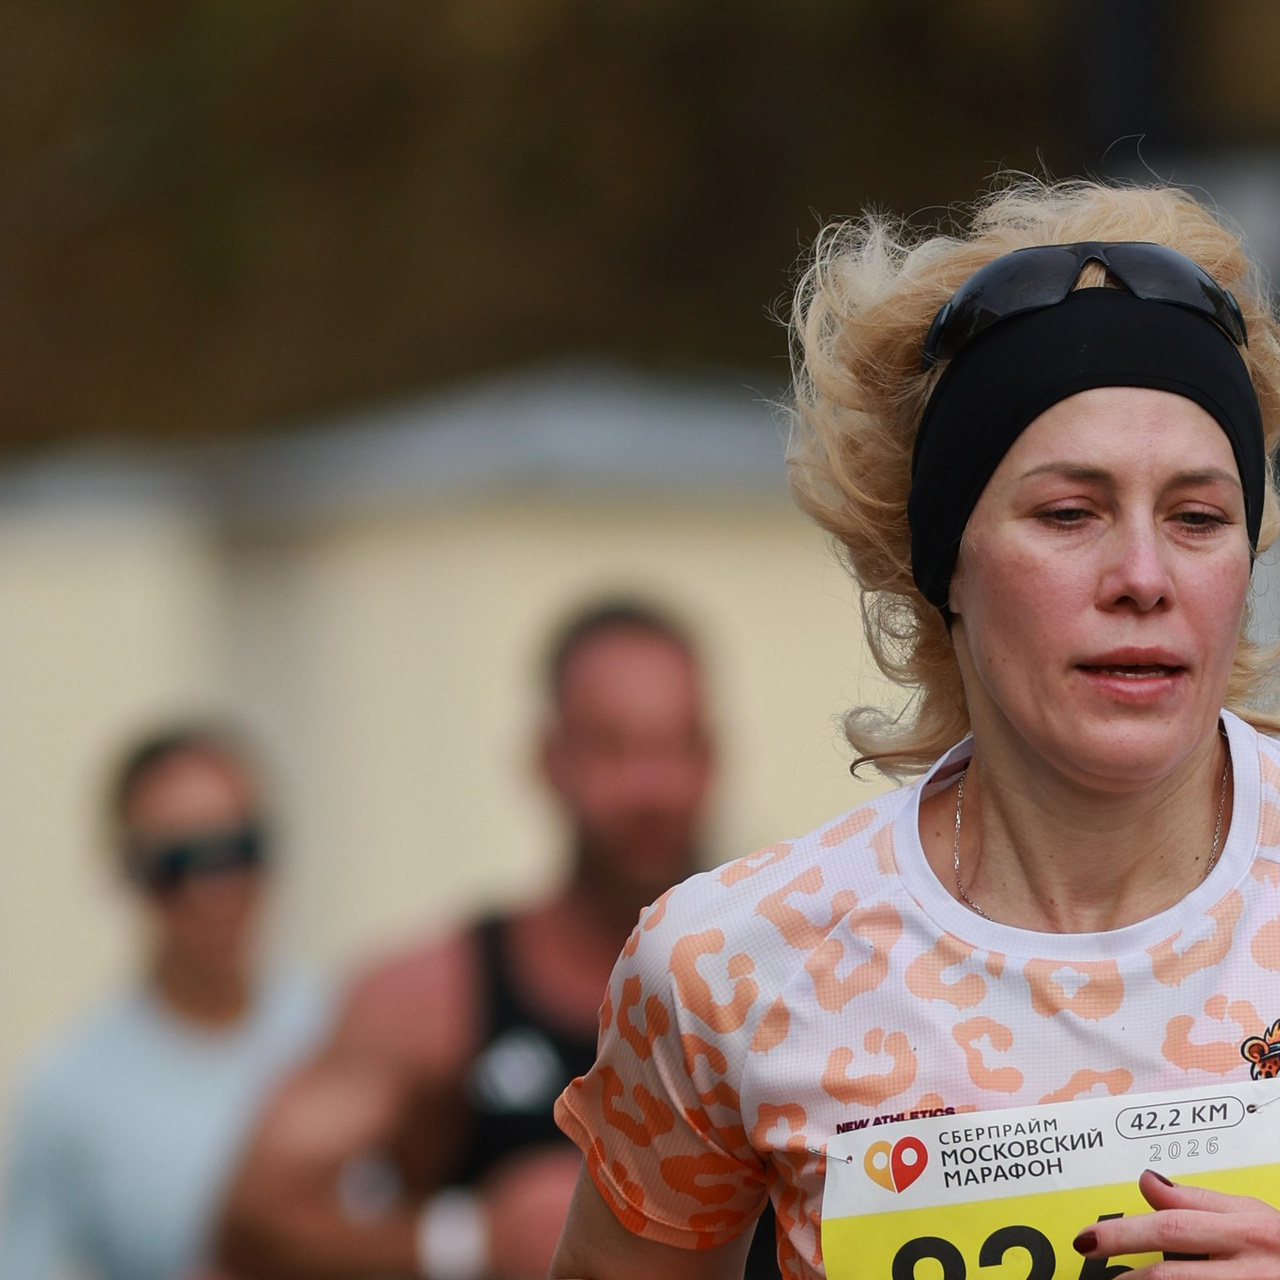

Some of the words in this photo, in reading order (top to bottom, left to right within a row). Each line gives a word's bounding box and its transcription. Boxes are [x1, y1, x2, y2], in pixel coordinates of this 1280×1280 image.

[836, 1117, 870, 1134] NEW
[872, 1107, 956, 1127] ATHLETICS
[938, 1118, 1058, 1146] СБЕРПРАЙМ
[1130, 1109, 1180, 1131] 42,2
[941, 1130, 1104, 1168] МОСКОВСКИЙ
[1149, 1137, 1219, 1162] 2026
[943, 1157, 1063, 1188] МАРАФОН
